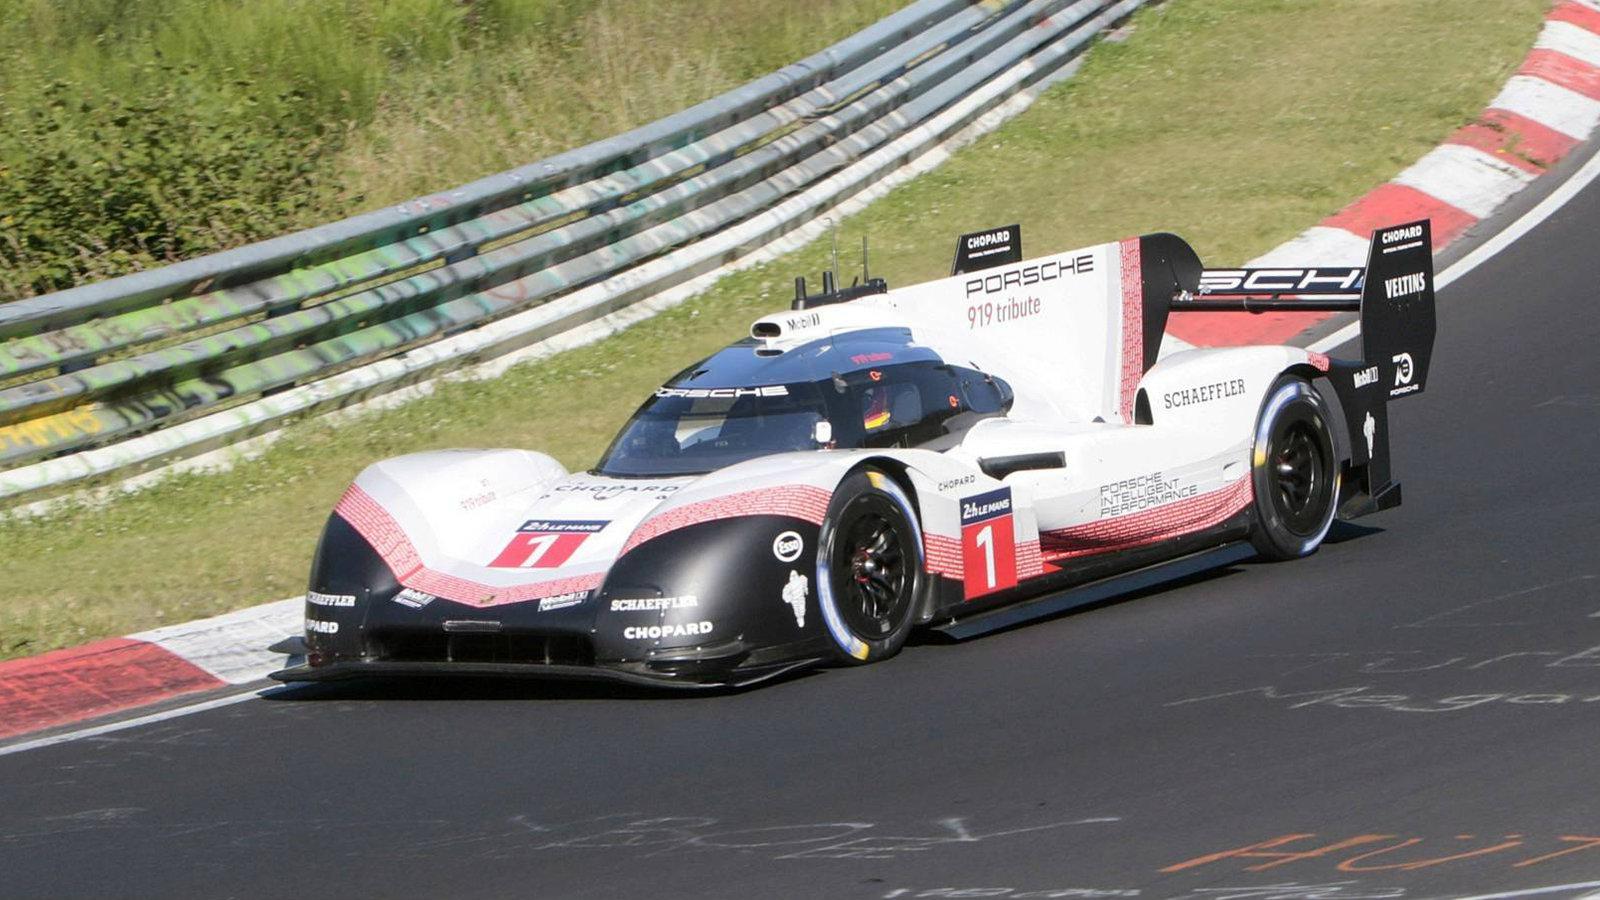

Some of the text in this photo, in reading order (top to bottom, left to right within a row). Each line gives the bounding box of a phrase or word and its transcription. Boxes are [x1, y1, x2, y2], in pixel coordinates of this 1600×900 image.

[968, 231, 1010, 249] CHOPARD
[1382, 225, 1422, 244] CHOPARD
[966, 254, 1094, 299] PORSCHE
[1385, 272, 1426, 299] VELTINS
[968, 296, 1041, 329] 919 tribute
[1164, 379, 1246, 409] SCHAEFFLER
[1390, 384, 1419, 396] PORSCHE
[555, 484, 679, 493] CHOPARD
[938, 475, 976, 491] CHOPARD
[1100, 472, 1162, 495] PORSCHE
[1101, 478, 1179, 507] INTELLIGENT
[988, 498, 1010, 512] MANS
[1101, 485, 1197, 518] PERFORMANCE
[520, 534, 560, 568] 1
[976, 525, 997, 589] 1
[610, 595, 699, 611] SCHAEFFLER
[624, 621, 713, 640] CHOPARD
